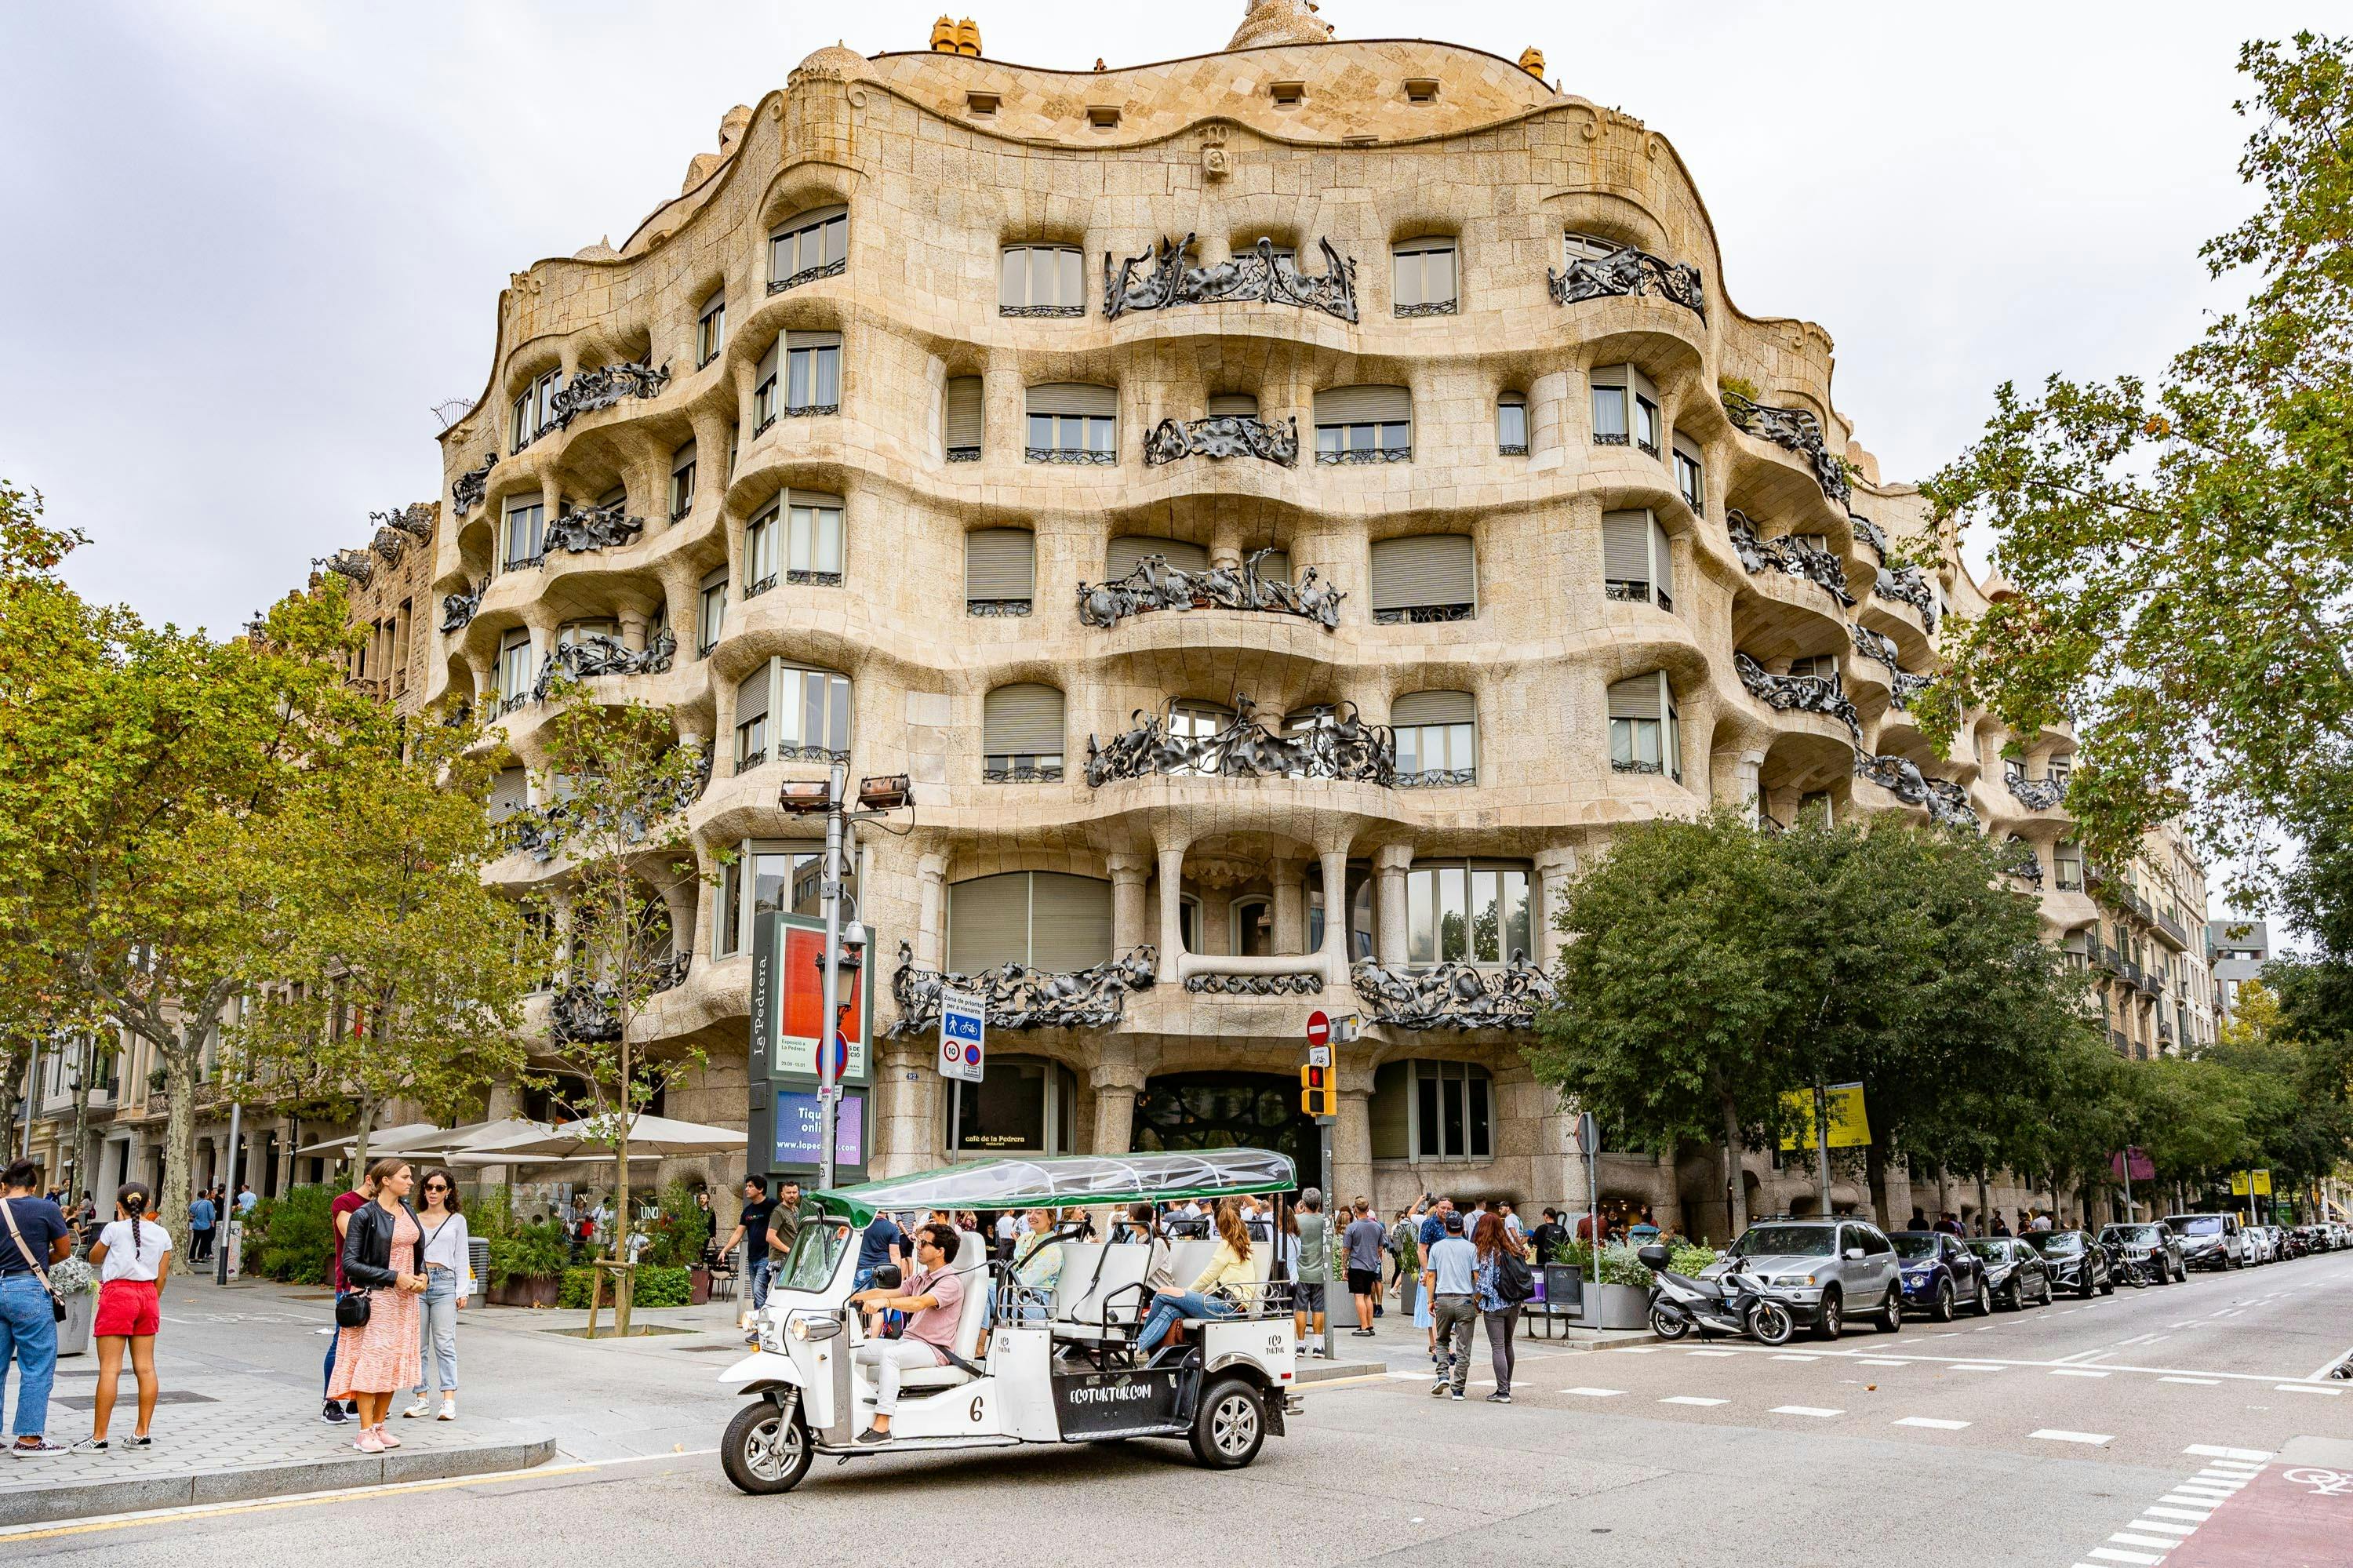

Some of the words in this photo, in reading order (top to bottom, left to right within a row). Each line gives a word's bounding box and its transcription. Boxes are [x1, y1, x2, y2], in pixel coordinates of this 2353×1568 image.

[755, 955, 767, 1034] Pedrera
[944, 995, 957, 1003] Zona
[965, 999, 984, 1010] prioritat
[960, 1006, 980, 1015] vianants
[754, 1035, 766, 1056] La
[947, 1047, 956, 1056] 10
[798, 1107, 821, 1122] Tiqu
[801, 1121, 821, 1133] onli
[1070, 1384, 1152, 1404] ECOTUKTUK.COM
[969, 1395, 984, 1422] 6
